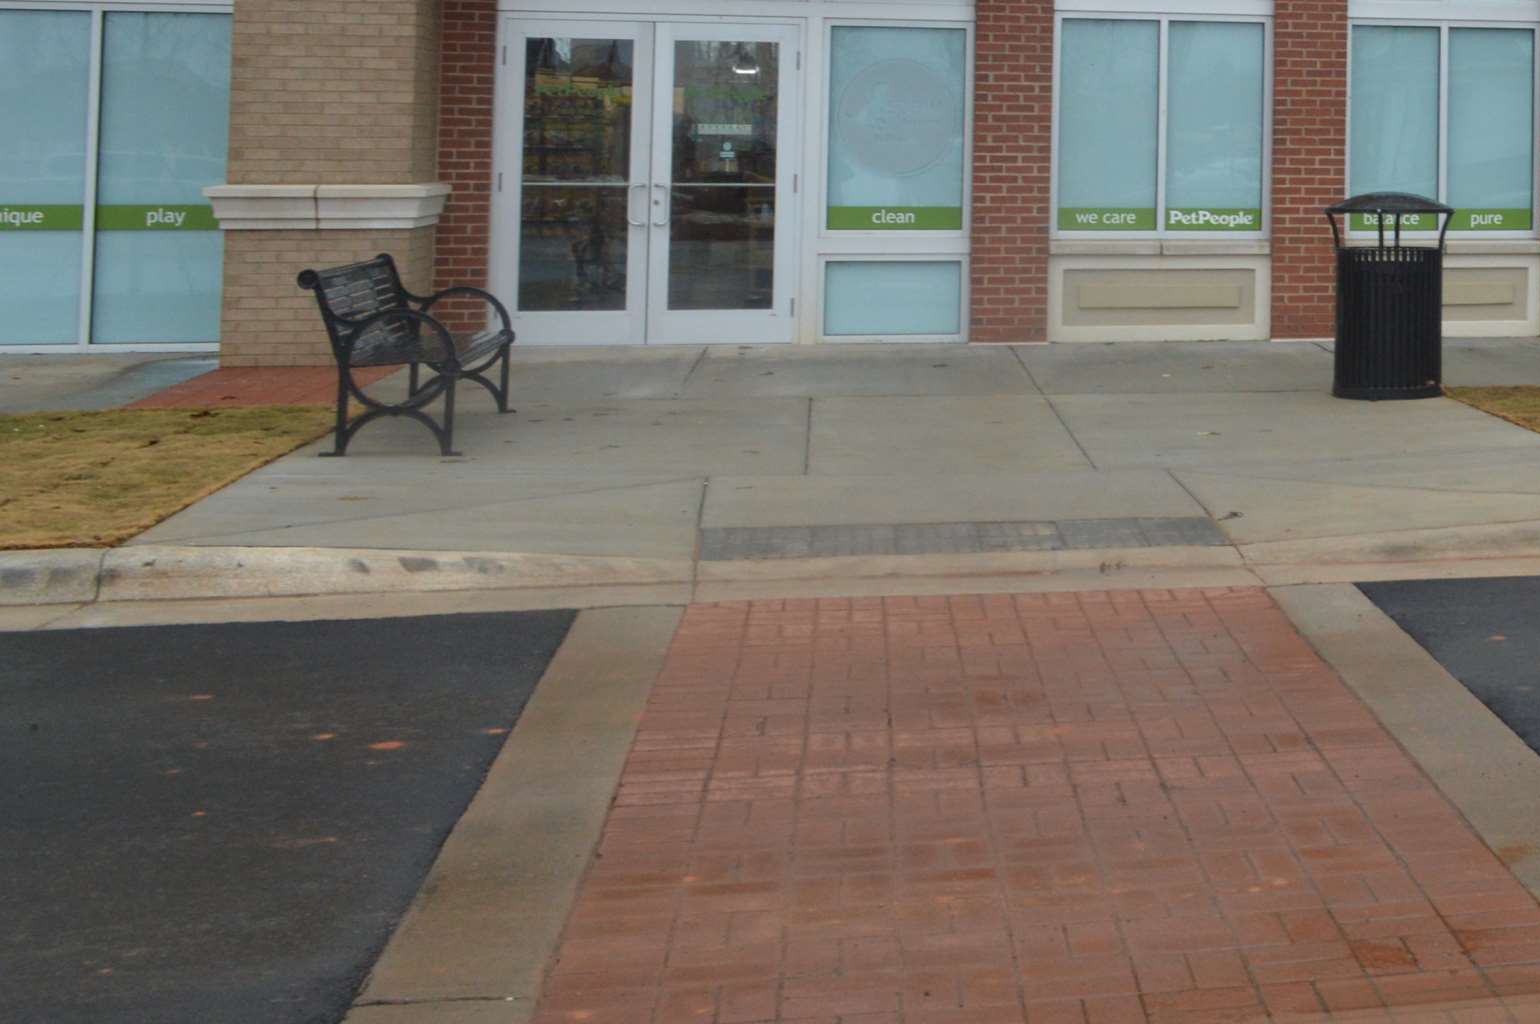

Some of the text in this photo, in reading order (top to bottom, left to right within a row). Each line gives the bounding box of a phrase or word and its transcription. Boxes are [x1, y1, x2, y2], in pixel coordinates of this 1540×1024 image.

[146, 208, 187, 226] play
[871, 209, 915, 224] clean
[1075, 211, 1137, 225] we care
[1168, 210, 1254, 227] PetPeople
[1363, 211, 1421, 225] baace
[1470, 213, 1504, 228] pure
